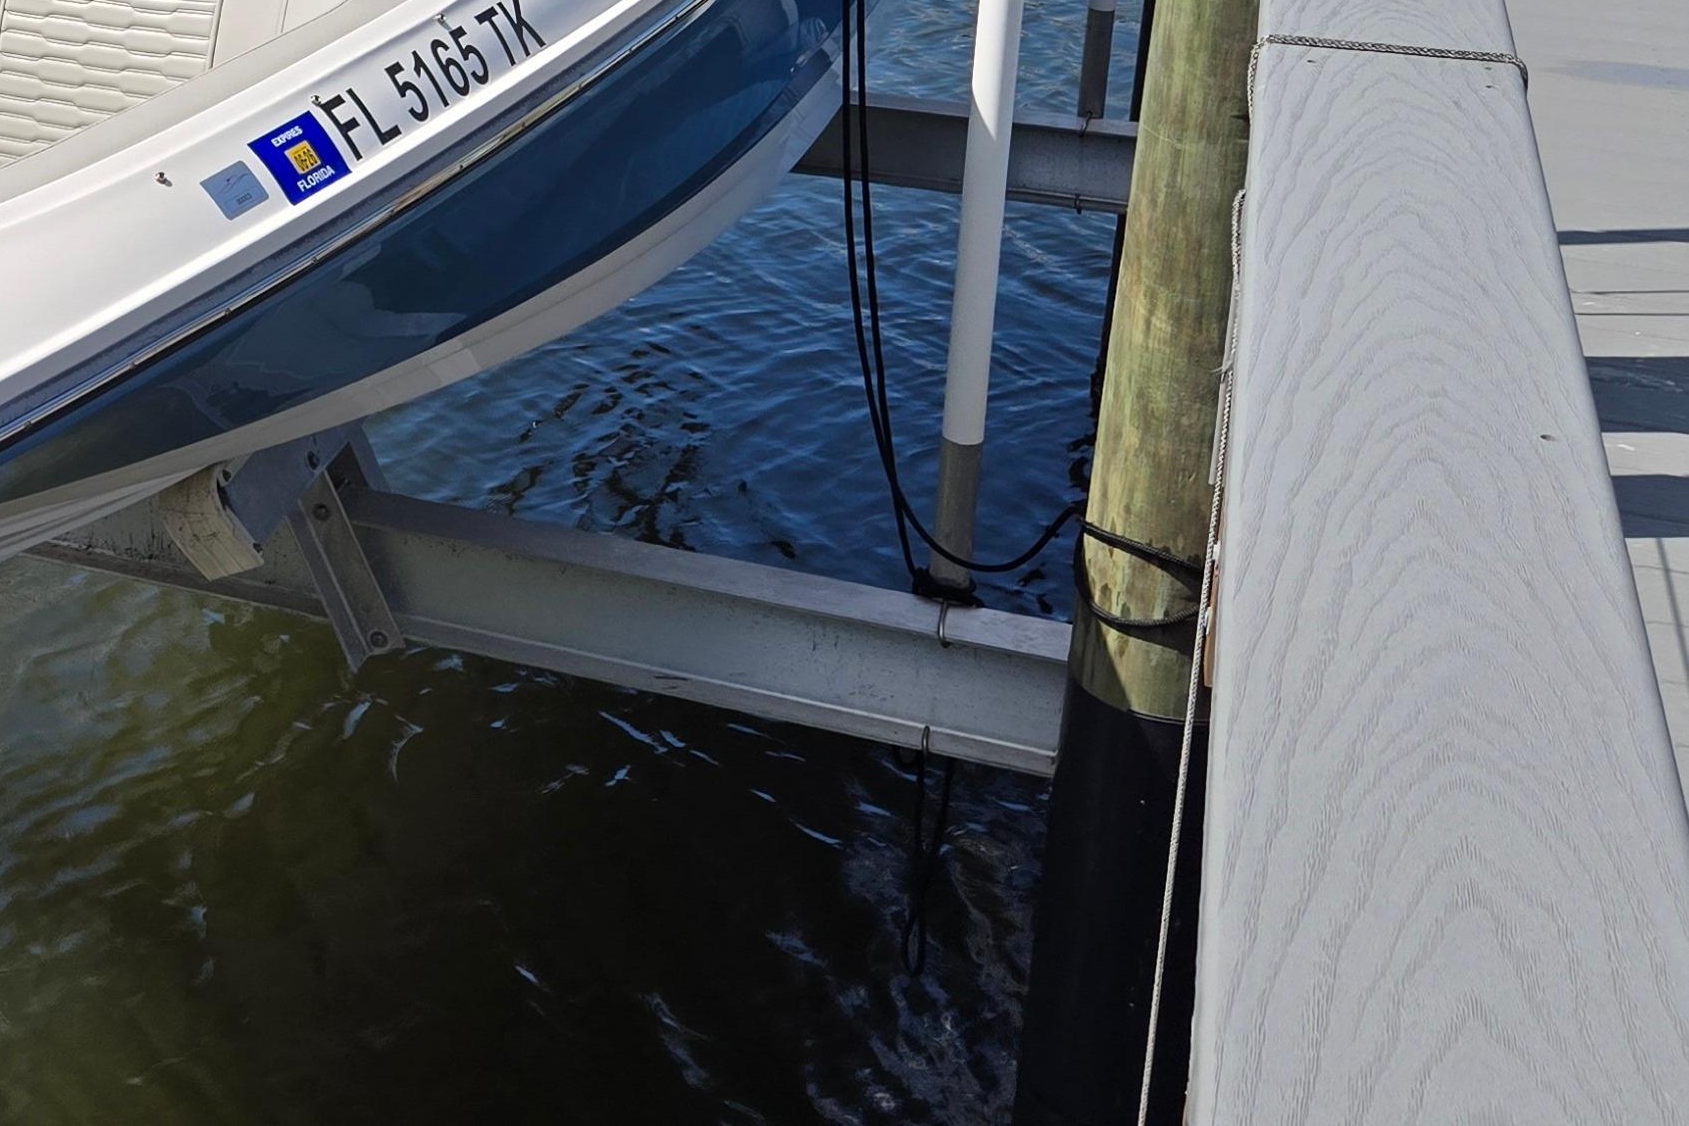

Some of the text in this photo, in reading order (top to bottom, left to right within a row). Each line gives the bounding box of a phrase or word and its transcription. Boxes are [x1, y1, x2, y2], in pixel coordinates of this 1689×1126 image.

[320, 87, 403, 162] FL
[383, 25, 490, 122] 5165
[270, 125, 304, 148] EXPIRES
[296, 164, 336, 193] FLORIDA
